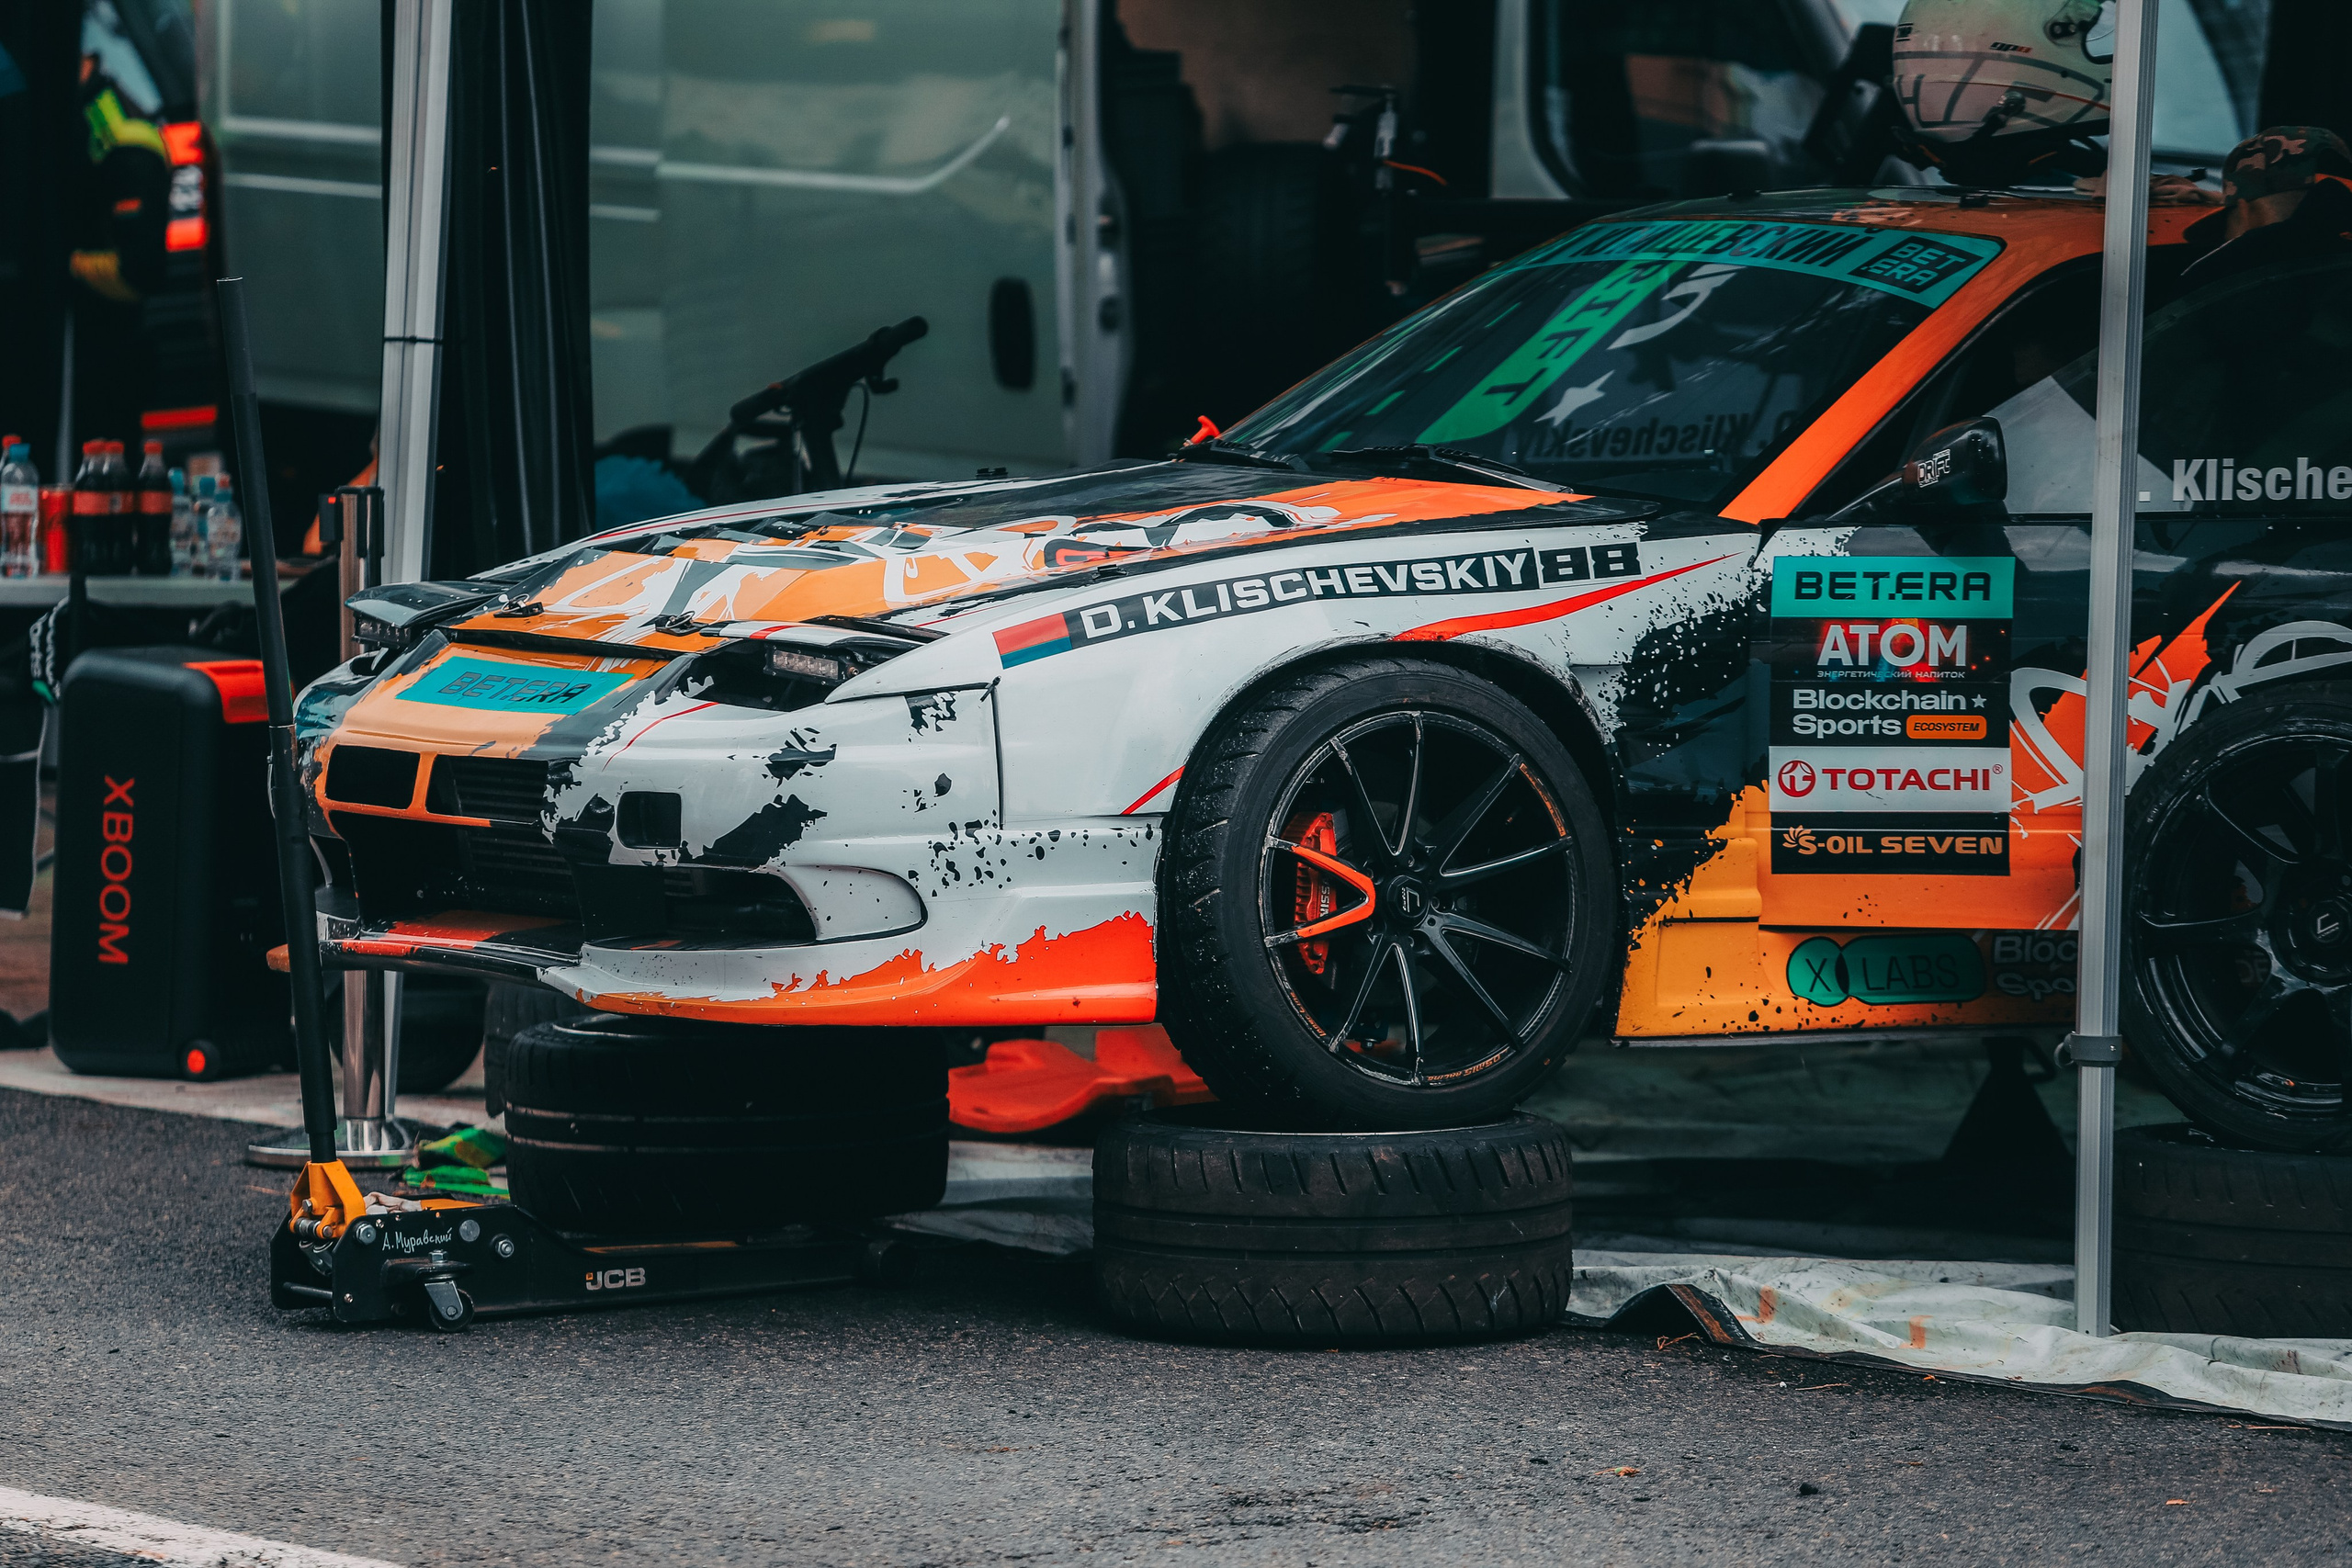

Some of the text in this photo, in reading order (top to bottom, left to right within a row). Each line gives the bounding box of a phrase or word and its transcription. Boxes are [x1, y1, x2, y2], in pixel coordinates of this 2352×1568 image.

[1890, 243, 1966, 270] BET
[1081, 542, 1643, 638] D. KLISCHEVSKIY 88
[1816, 624, 1967, 667] ATOM
[1816, 669, 1965, 680] ЭНЕРГЕТИЧЕСКИЙ НАПИТОК
[1792, 689, 1966, 711] Blockchain
[1792, 714, 1980, 739] Sports ECOSYSTEM
[1796, 832, 2003, 855] S-OIL SEVEN
[97, 773, 136, 964] XBOOM
[1804, 953, 1960, 994] X LABS
[586, 1268, 646, 1291] JCB
